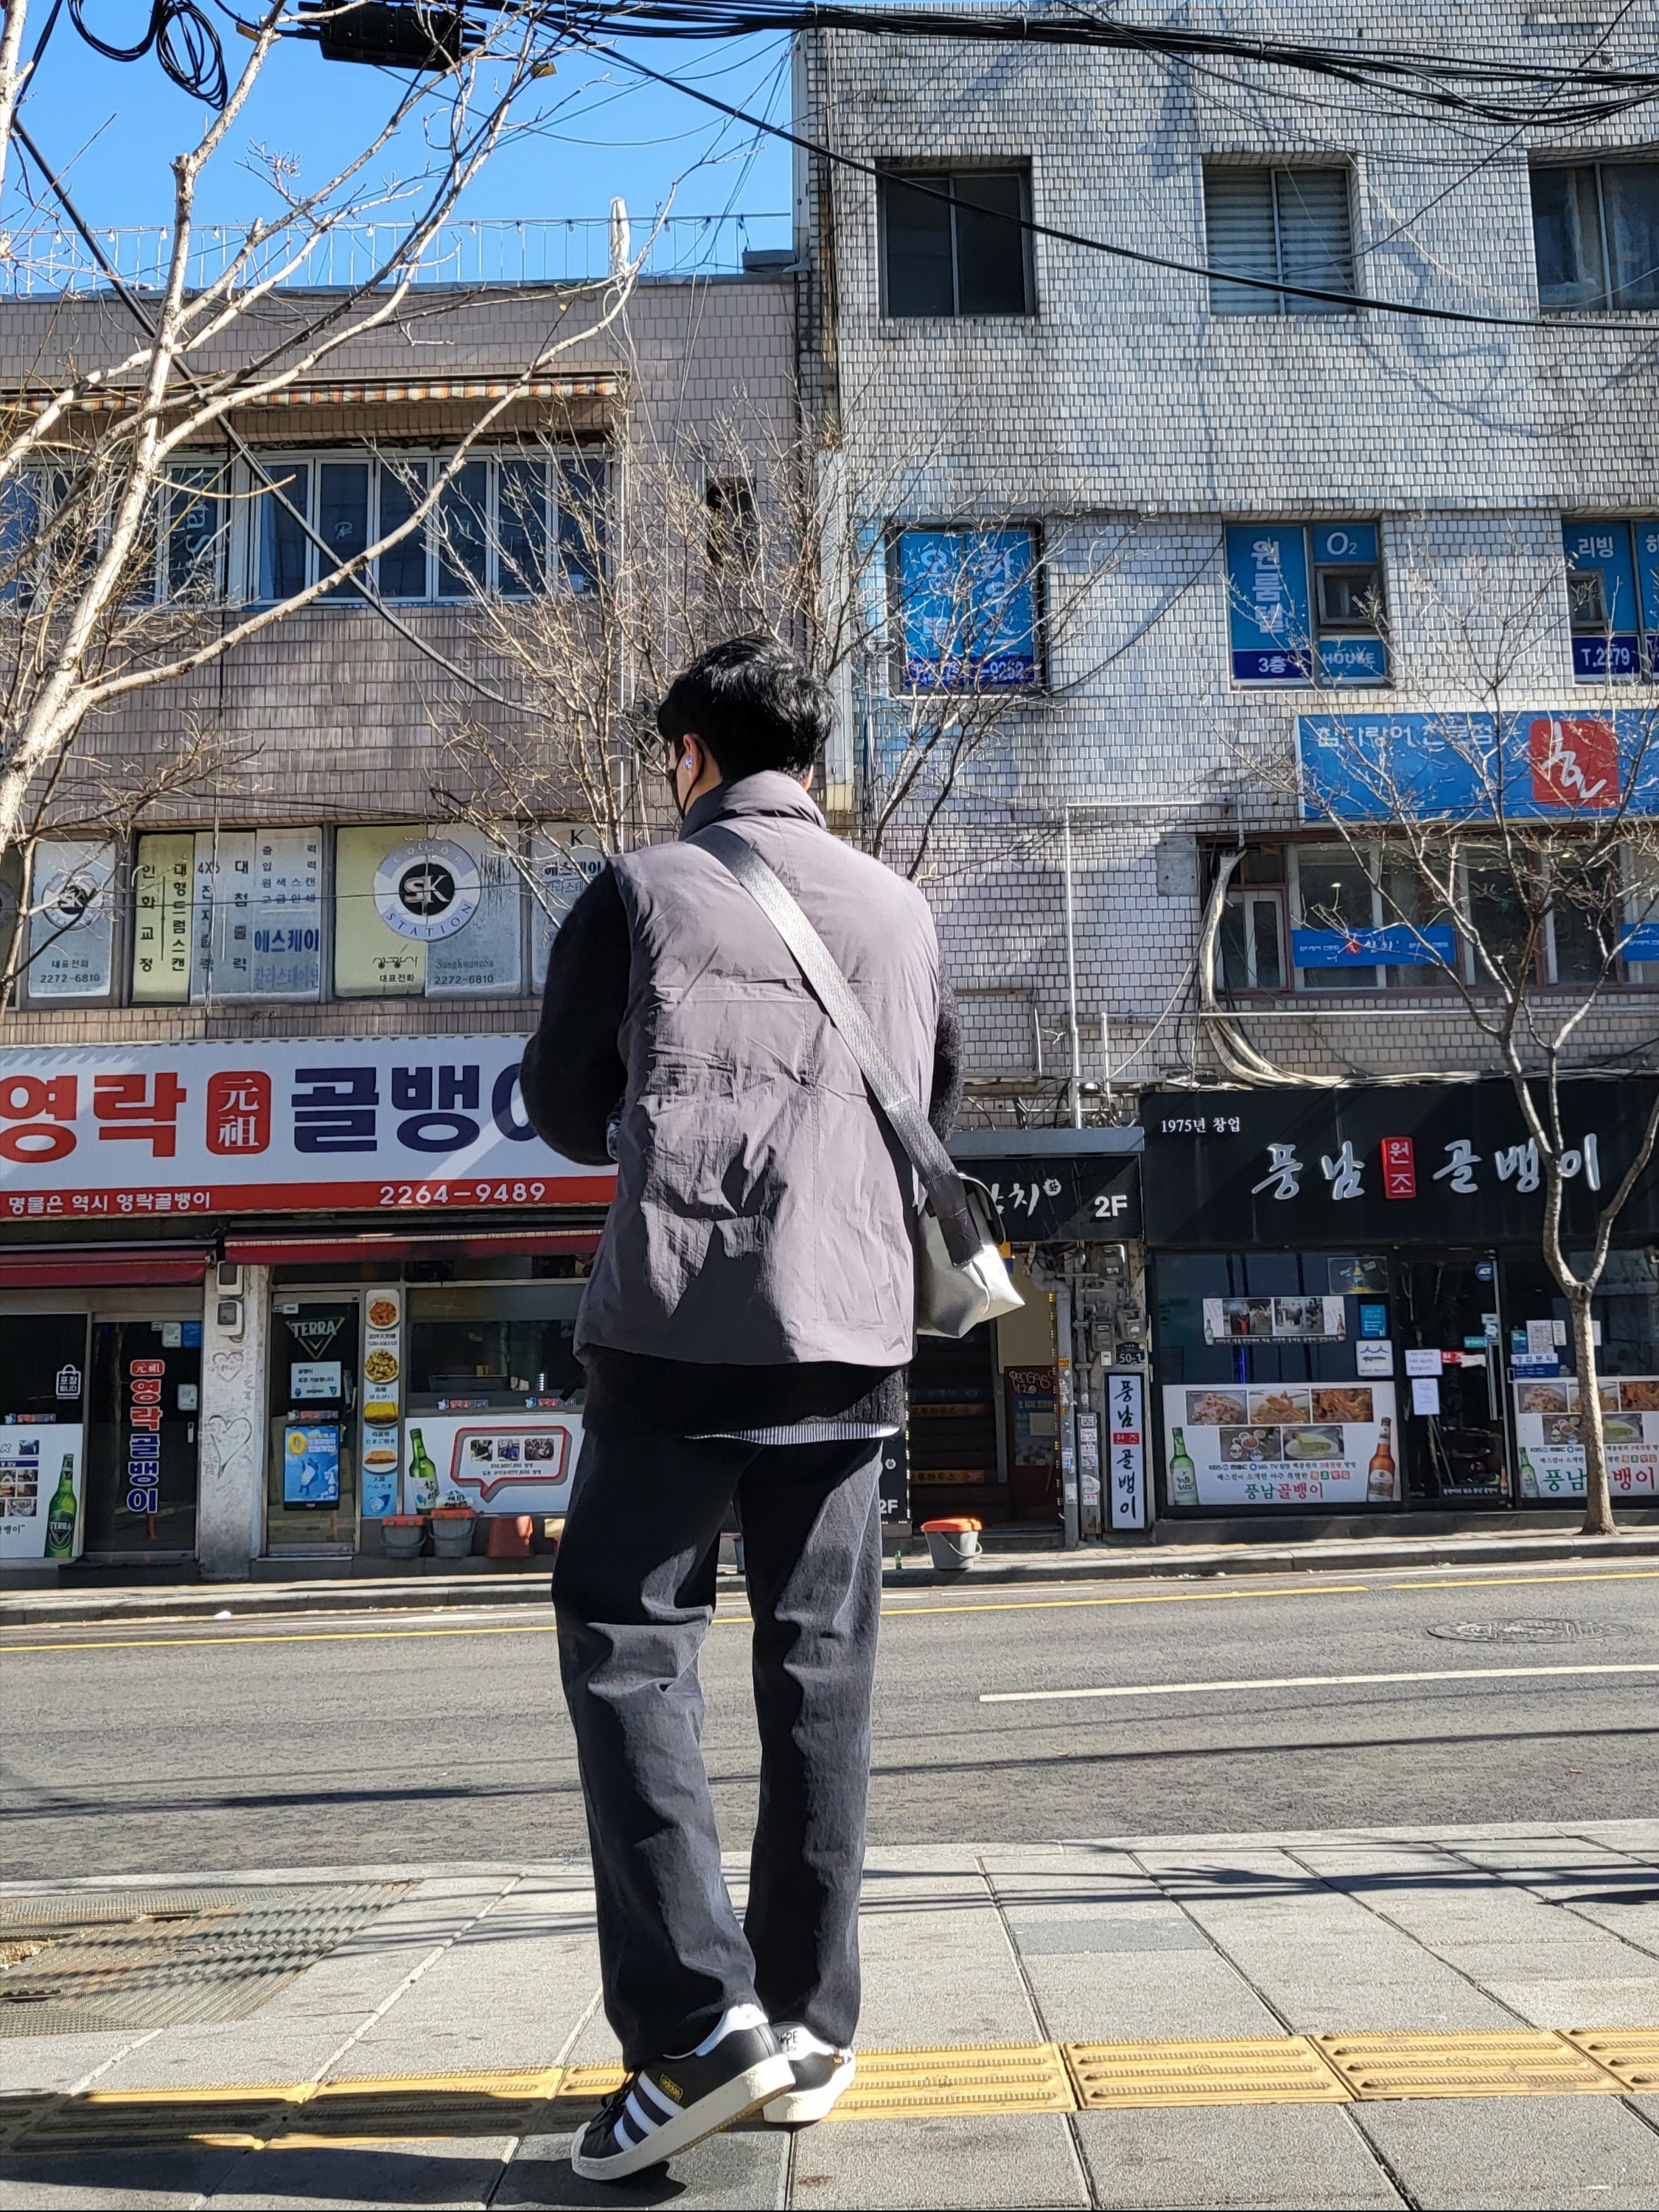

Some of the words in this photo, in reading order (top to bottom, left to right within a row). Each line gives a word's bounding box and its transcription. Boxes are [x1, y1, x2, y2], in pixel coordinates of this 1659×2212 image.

[1578, 536, 1614, 558] 리빙
[1258, 655, 1287, 673] 3층
[1321, 652, 1376, 665] HOUSE
[1581, 646, 1630, 667] T.2279
[262, 878, 315, 888] 원색스캔
[404, 875, 450, 903] SK
[139, 864, 156, 973] 인화교정
[172, 864, 187, 972] 대형드럼스캔
[385, 904, 472, 937] STATION
[254, 929, 319, 953] 에스케이
[52, 960, 89, 968] 대표전화
[40, 974, 100, 984] 2272-6810
[380, 974, 415, 983] 대표전화
[435, 975, 494, 984] 2272-6810
[0, 1073, 187, 1163] 영락
[218, 1078, 261, 1148] 元祖
[1161, 1117, 1206, 1133] 1975년
[1212, 1116, 1240, 1133] 창업
[1251, 1141, 1365, 1200] 풍남
[1389, 1141, 1413, 1194] 원조
[1433, 1133, 1601, 1194] 골뱅이
[9, 1196, 63, 1215] 명물은
[72, 1194, 108, 1212] 역시
[116, 1191, 210, 1212] 영락골뱅이
[380, 1182, 546, 1206] 2264-9489
[1094, 1194, 1128, 1218] 2F
[290, 1320, 337, 1339] TERRA
[60, 1376, 77, 1385] 포장
[1114, 1380, 1134, 1428] 풍남
[127, 1379, 163, 1513] 영락골뱅이
[1117, 1449, 1136, 1519] 골뱅이
[1543, 1466, 1655, 1492] 풍남뱅이
[1244, 1482, 1324, 1500] 풍남골뱅이
[880, 1499, 898, 1514] 2F
[49, 1522, 71, 1531] TERRA
